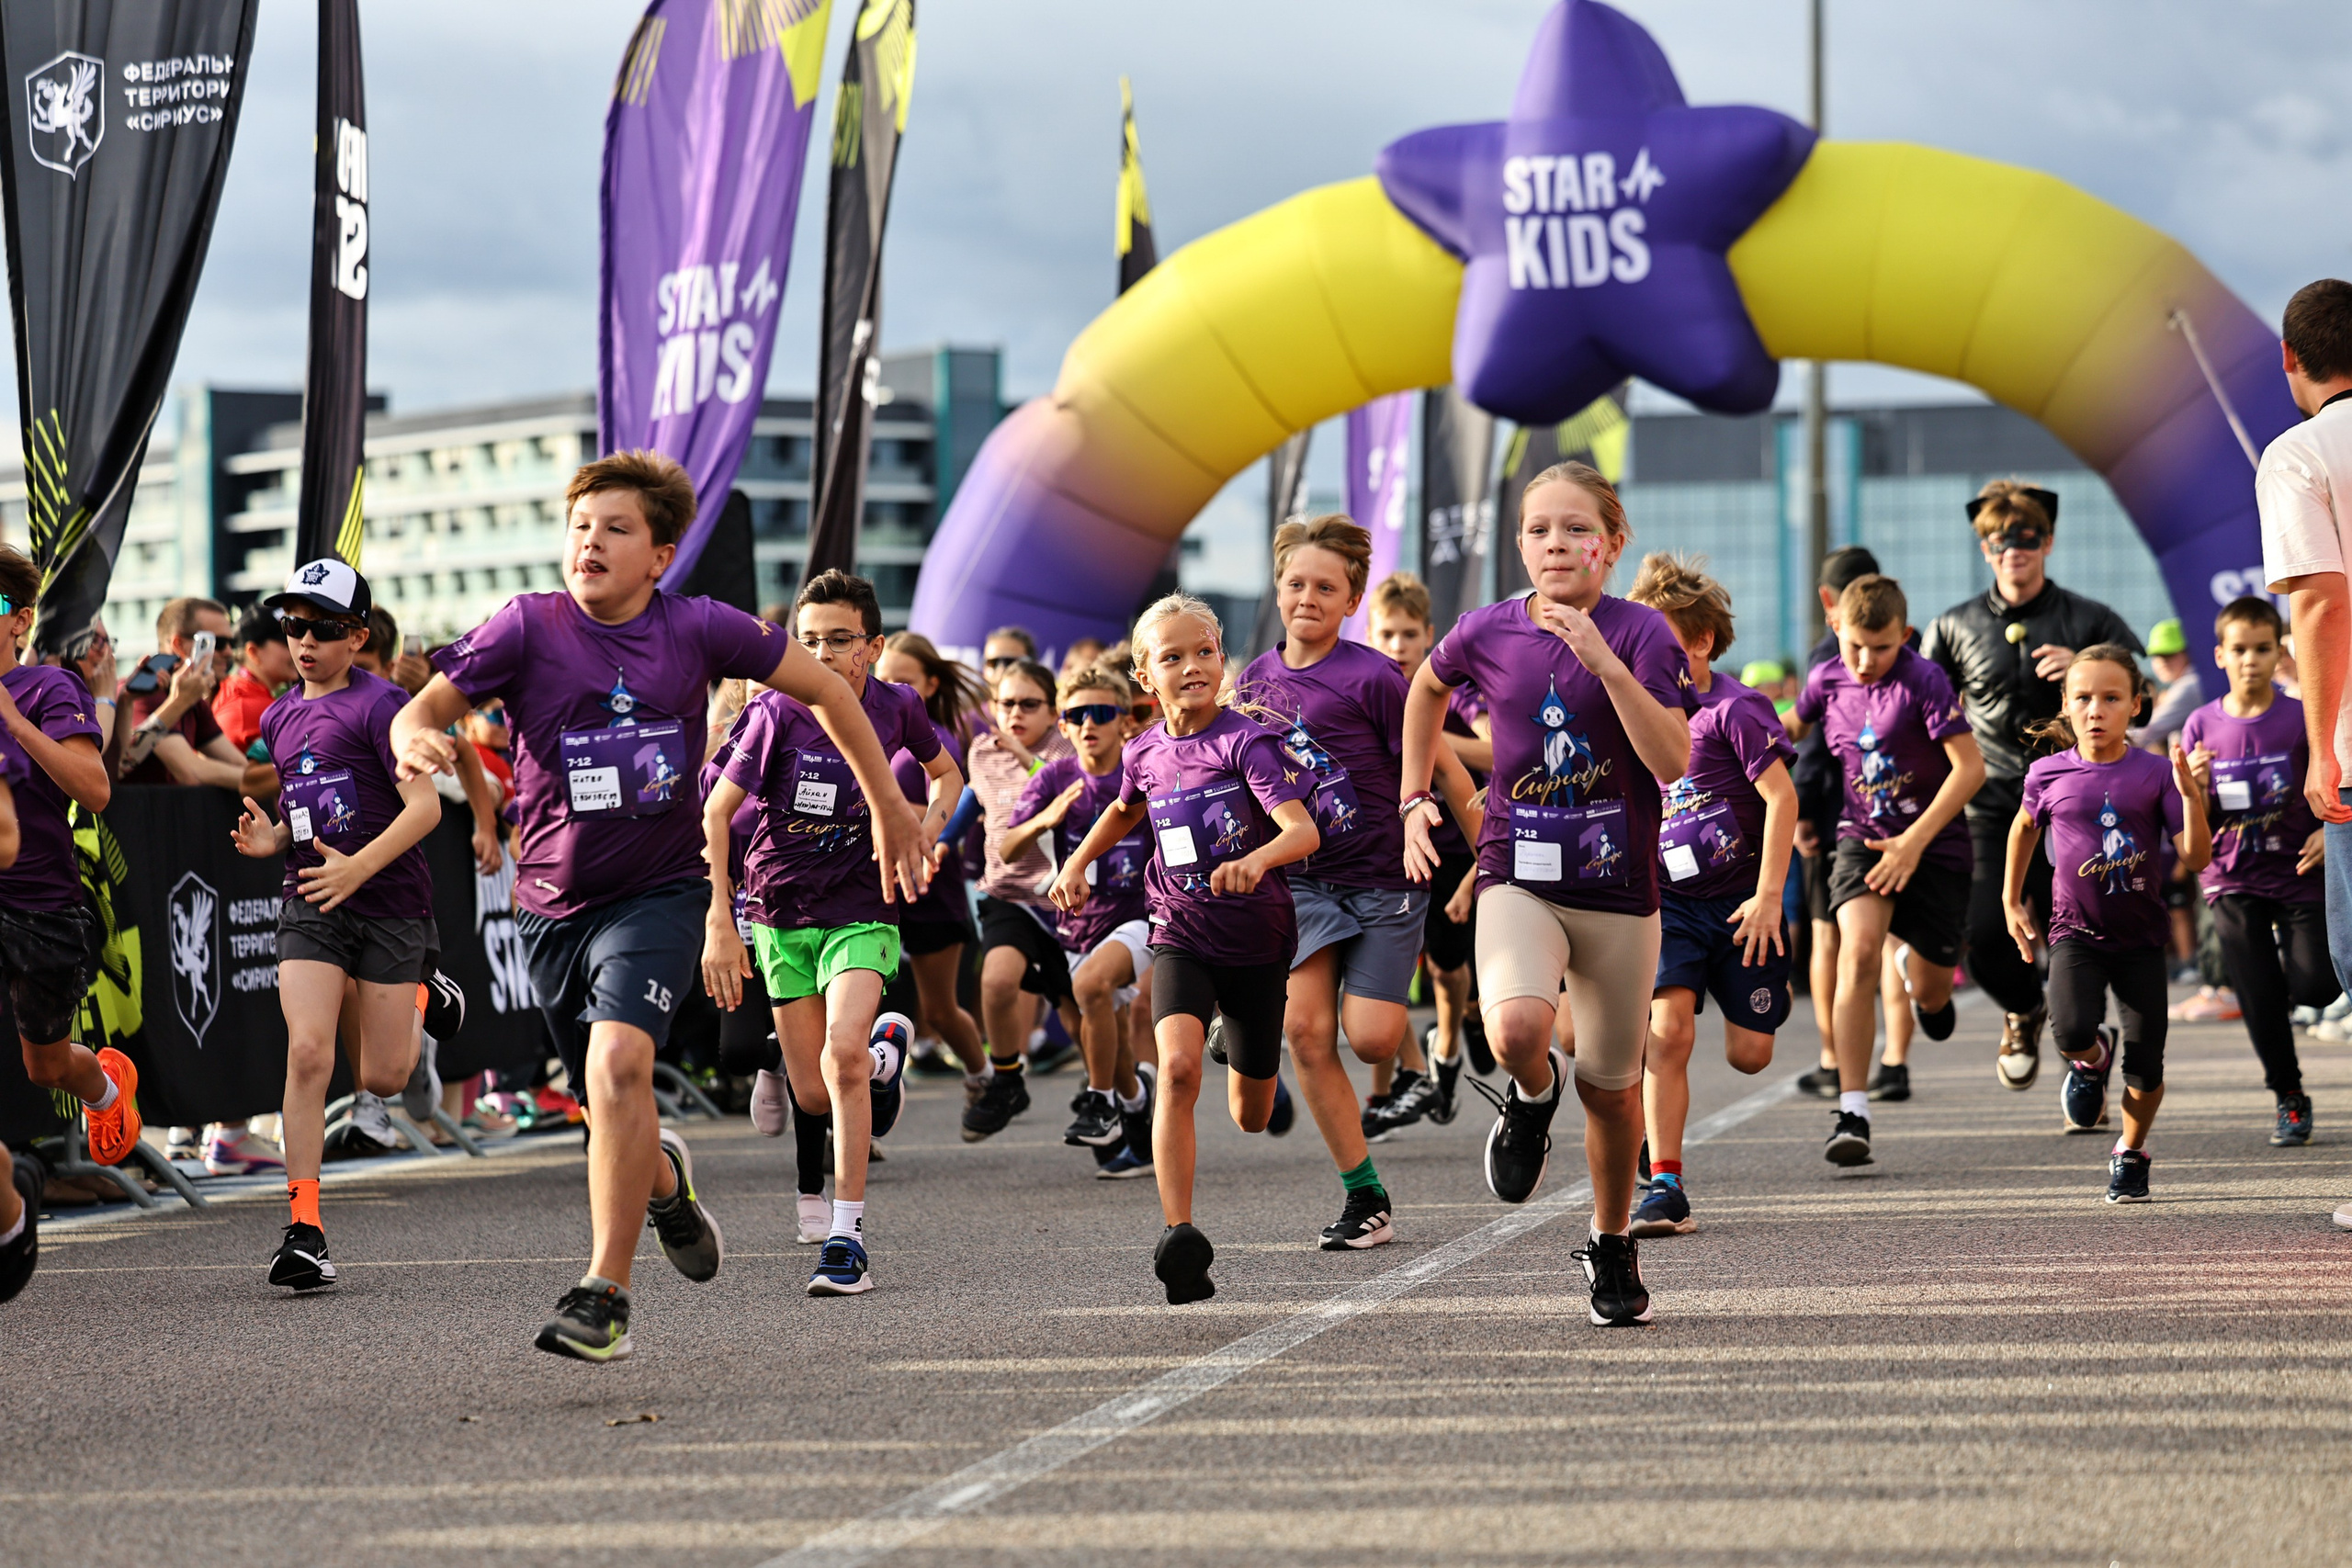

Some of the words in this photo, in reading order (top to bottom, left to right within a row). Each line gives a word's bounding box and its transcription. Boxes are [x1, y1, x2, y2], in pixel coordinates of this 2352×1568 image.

[1502, 151, 1617, 215] STAR
[1504, 207, 1652, 290] KIDS
[566, 756, 593, 768] 7-12
[799, 771, 820, 780] 7-12
[1514, 828, 1538, 839] 7-12
[232, 964, 279, 992] «СИРИУС
[643, 978, 673, 1013] 15
